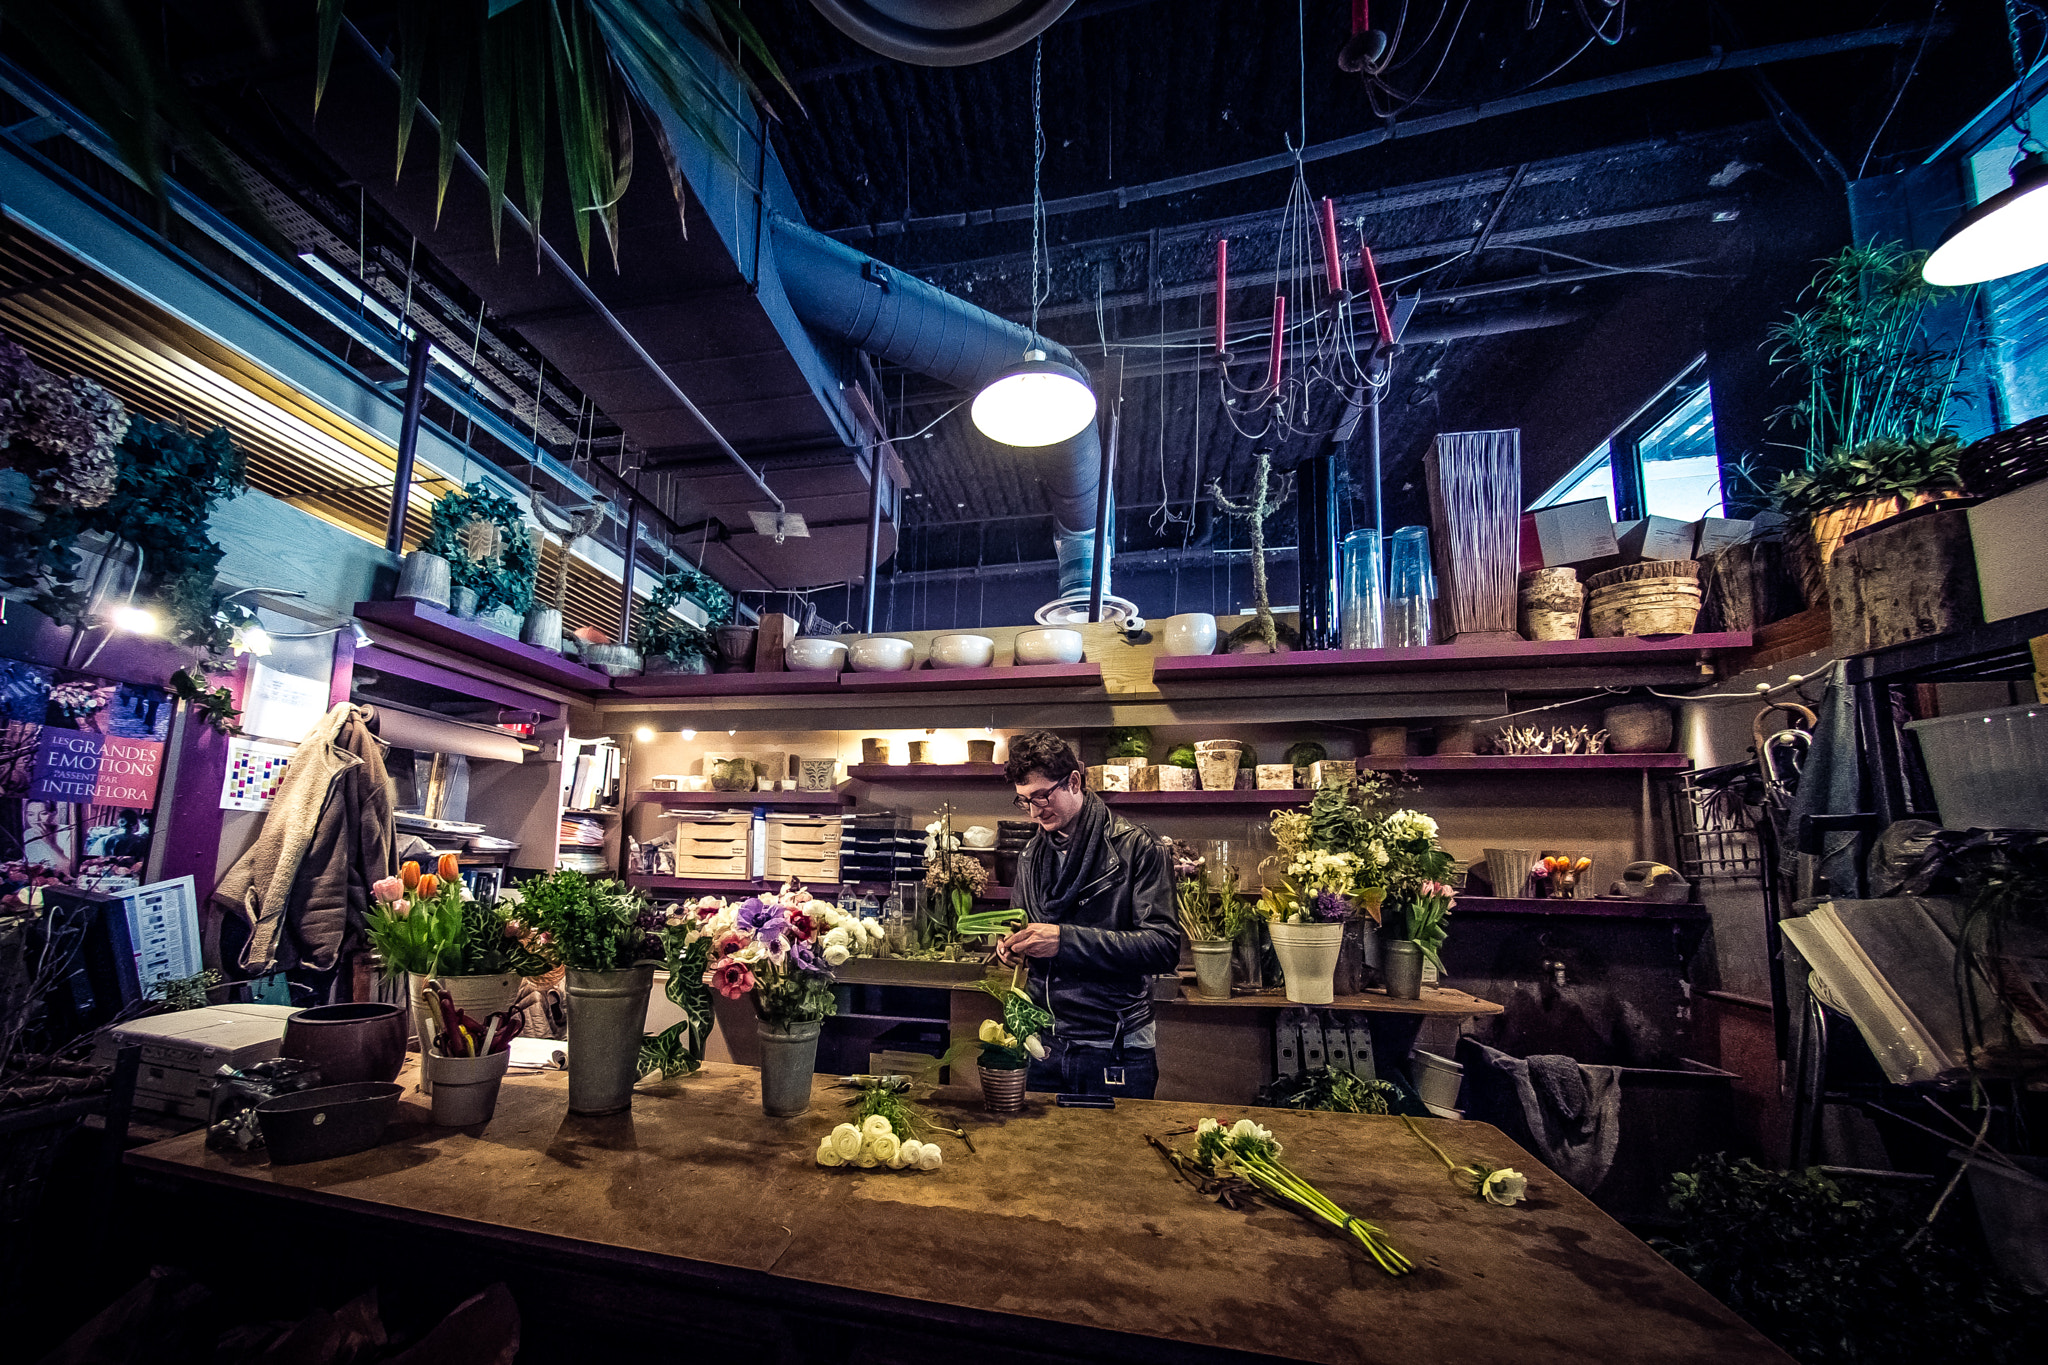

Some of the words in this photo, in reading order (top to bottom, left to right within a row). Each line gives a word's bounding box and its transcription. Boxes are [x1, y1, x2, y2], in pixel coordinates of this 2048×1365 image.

[52, 736, 70, 746] LES
[69, 738, 158, 762] GRANDES
[48, 751, 155, 777] EMOTIONS
[41, 779, 148, 801] INTERFLORA
[100, 774, 118, 784] PAR
